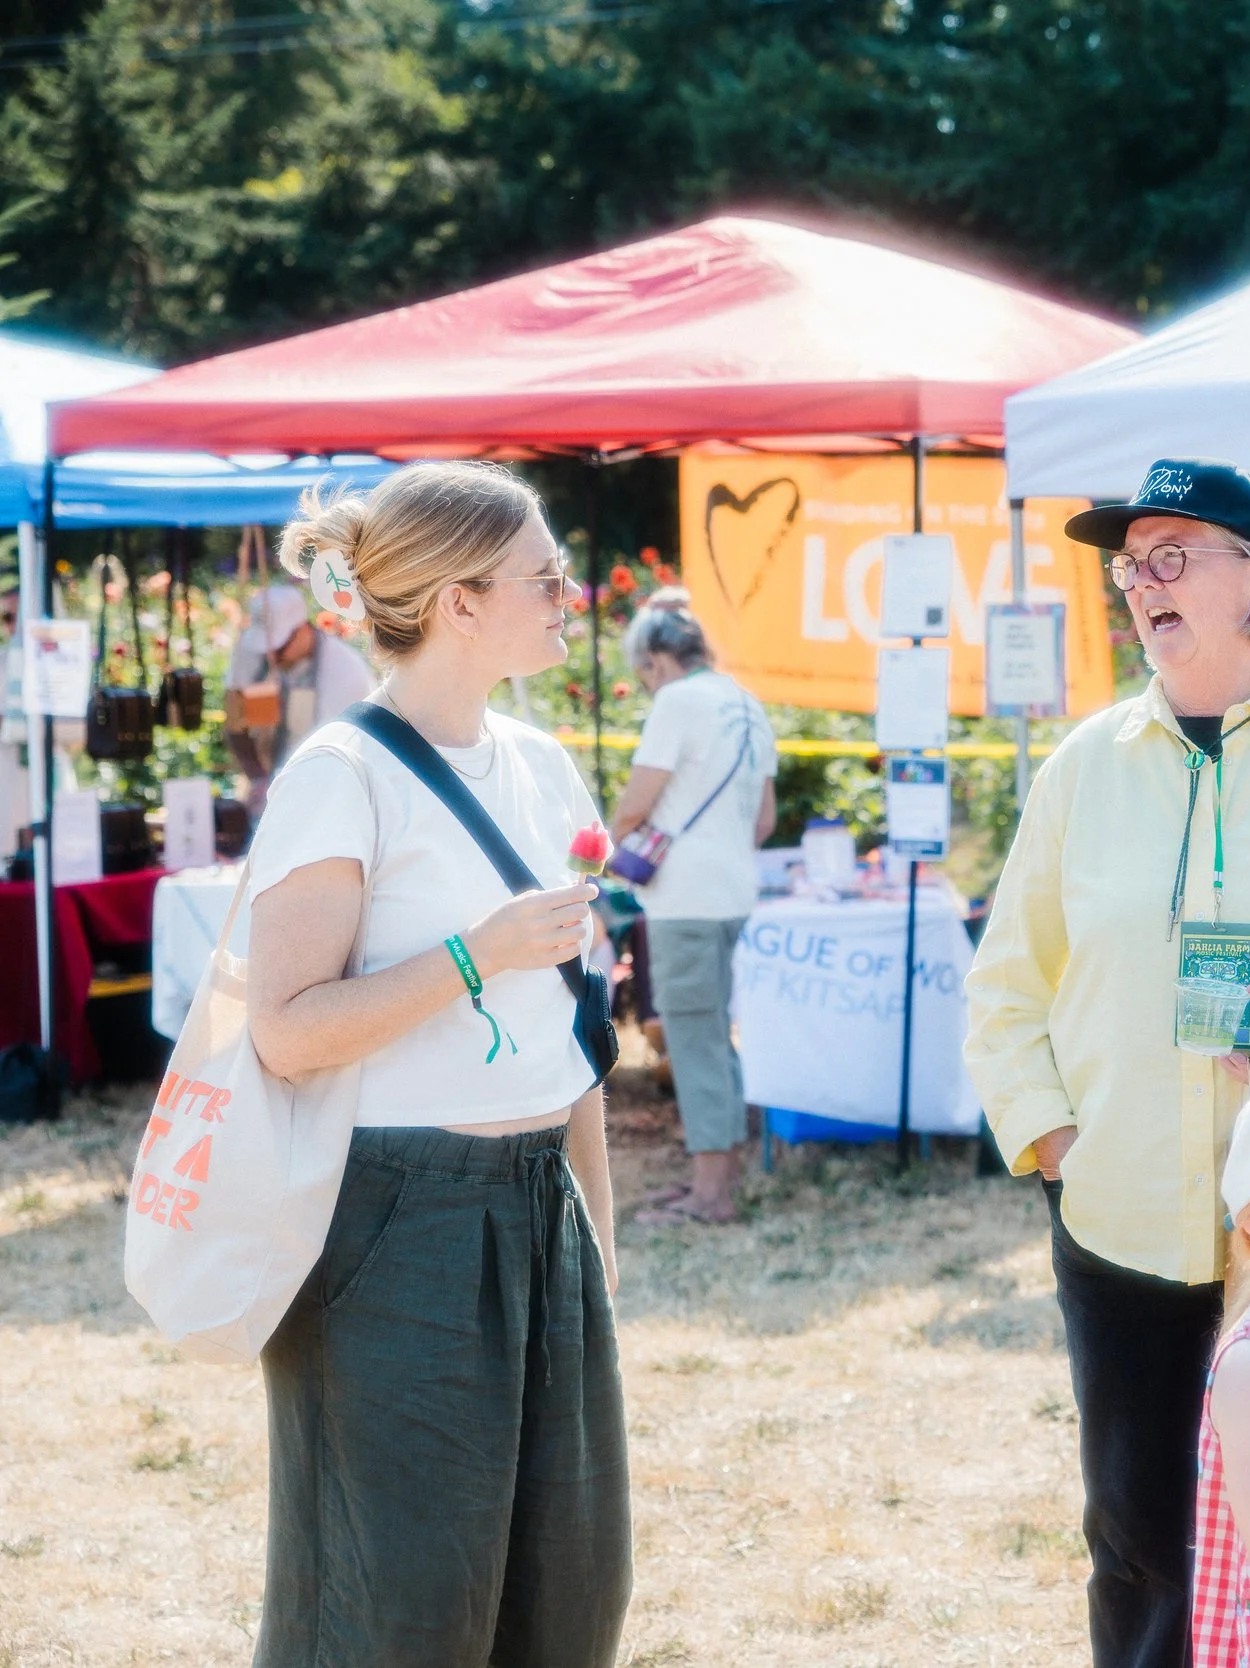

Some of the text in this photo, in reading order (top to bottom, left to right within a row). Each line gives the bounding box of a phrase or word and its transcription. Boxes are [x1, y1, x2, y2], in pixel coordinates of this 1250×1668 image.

[452, 942, 467, 965] Music
[1188, 943, 1250, 953] DAHLIA FARM
[846, 949, 893, 978] OF
[913, 958, 962, 995] WO
[172, 1134, 213, 1184] A
[133, 1170, 200, 1232] DER
